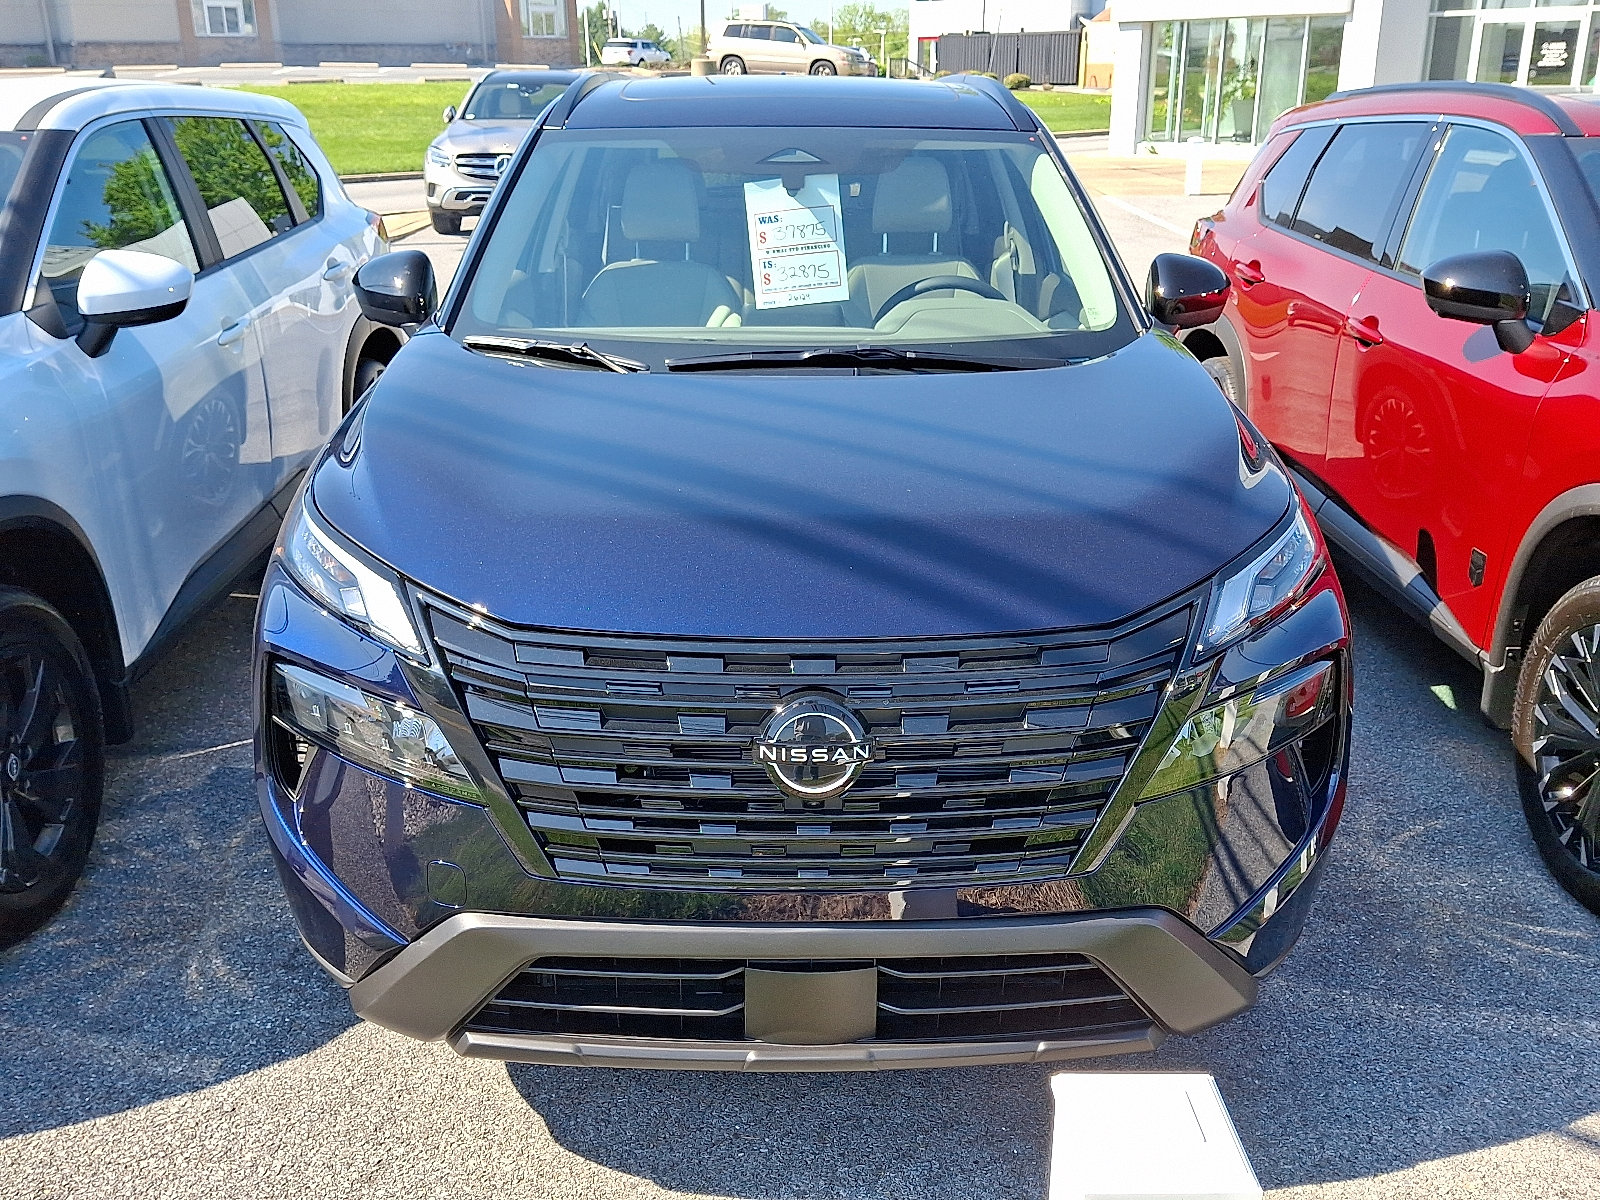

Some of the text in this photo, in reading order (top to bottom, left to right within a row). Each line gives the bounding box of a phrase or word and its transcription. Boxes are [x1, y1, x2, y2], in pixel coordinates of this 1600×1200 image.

[758, 215, 783, 225] WAS:
[772, 221, 826, 240] 37875
[763, 261, 777, 269] IS:
[777, 263, 830, 281] 32875
[759, 745, 869, 762] NISSAN
